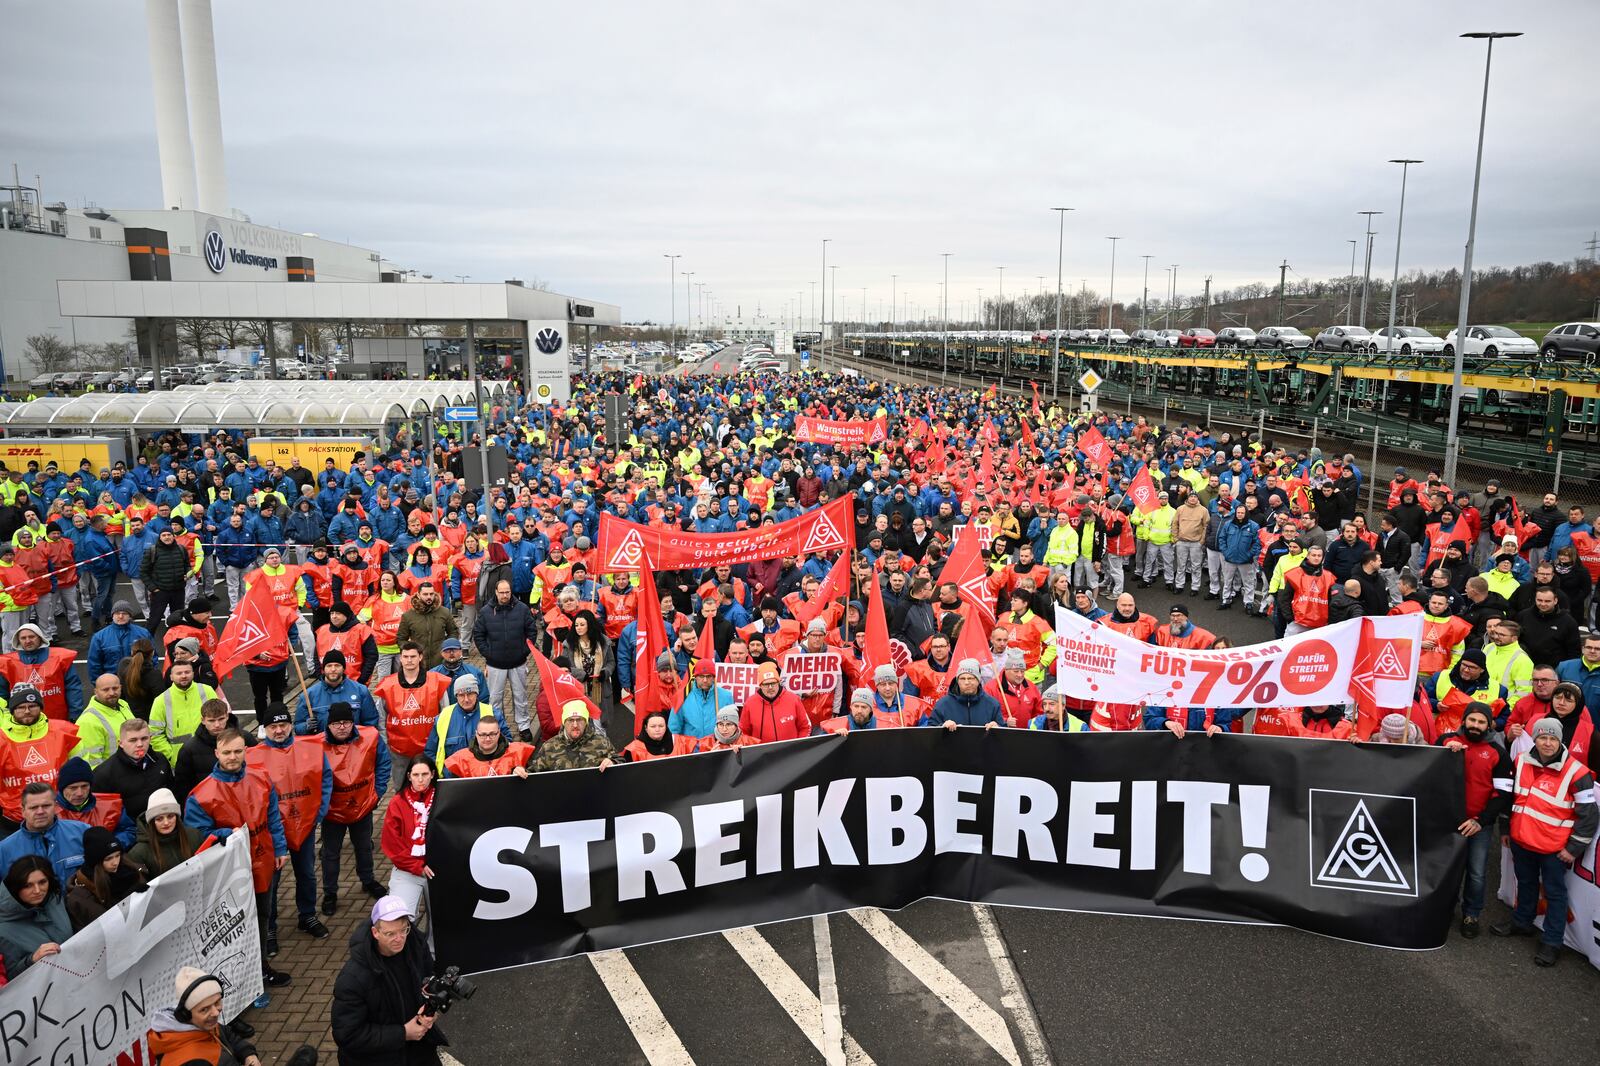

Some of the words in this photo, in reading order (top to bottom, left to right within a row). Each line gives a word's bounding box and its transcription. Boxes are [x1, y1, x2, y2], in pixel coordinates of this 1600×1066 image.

[229, 247, 278, 271] Volkswagen
[816, 423, 864, 435] Warnstreik
[7, 448, 44, 456] DHL
[694, 548, 728, 560] gute
[1057, 636, 1117, 658] LIDARITÄT
[787, 655, 839, 673] MEHR
[1064, 660, 1101, 673] TARIFBEWEGUNG
[1065, 650, 1117, 669] GEWINNT
[1297, 652, 1325, 664] DAFÜR
[716, 666, 758, 684] MEH
[1140, 651, 1187, 678] FÜR
[1190, 660, 1279, 704] 7%
[1289, 664, 1329, 674] STREITEN
[789, 673, 835, 690] GELD
[1298, 674, 1316, 683] WIR
[1260, 714, 1275, 724] Wir
[3, 776, 22, 787] Wir
[470, 772, 1270, 919] STREIKBEREIT!
[195, 900, 229, 935] UNSER
[200, 909, 232, 943] LEBEN
[203, 911, 244, 955] gestalten
[221, 922, 247, 948] WIR!
